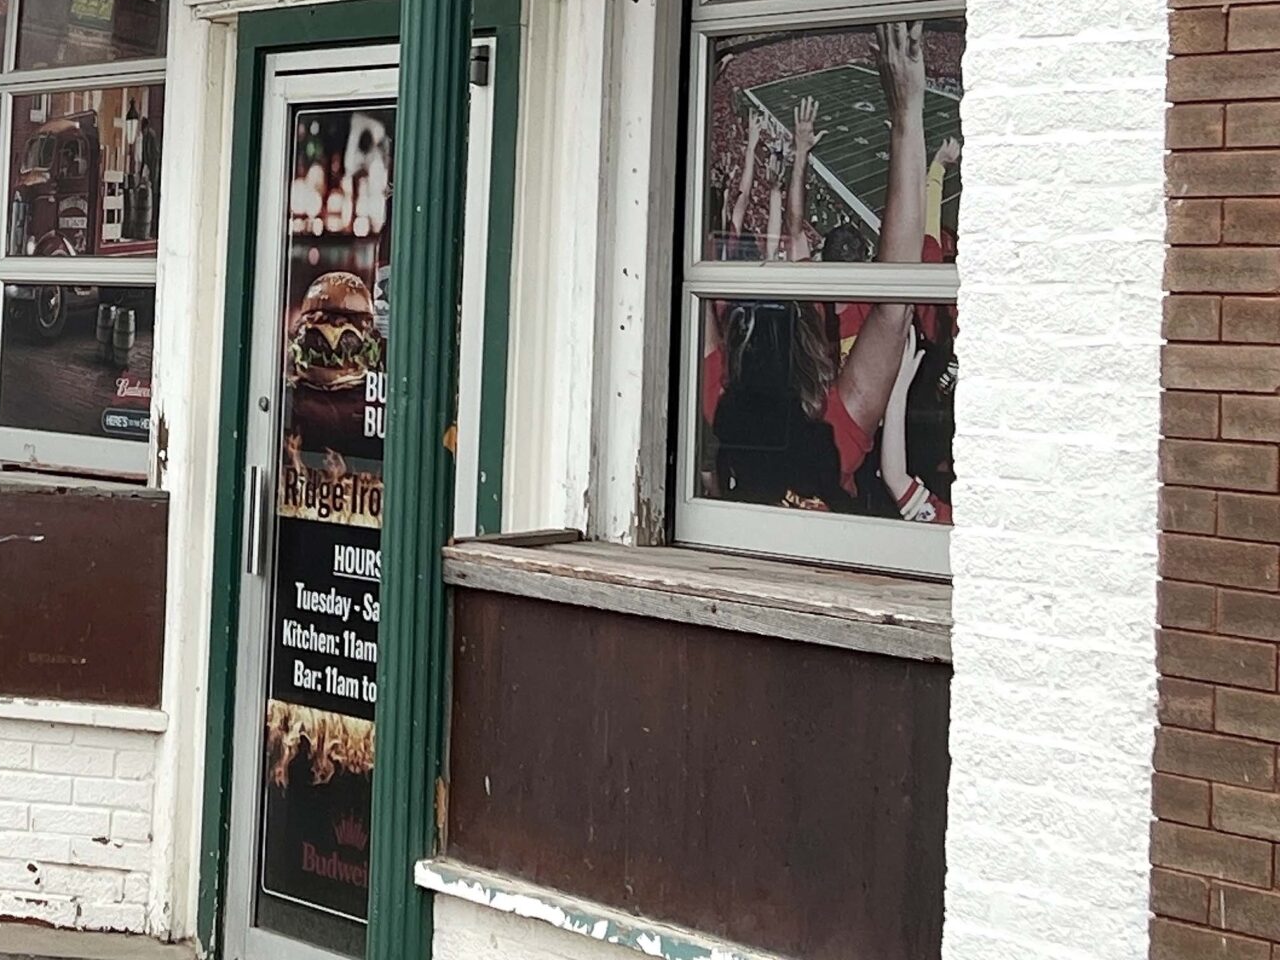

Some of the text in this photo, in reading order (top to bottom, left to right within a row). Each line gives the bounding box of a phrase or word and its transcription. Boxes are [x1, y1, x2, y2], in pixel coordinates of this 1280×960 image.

[284, 468, 344, 518] Ridge
[295, 581, 352, 622] Tuesday
[353, 604, 361, 612] -
[282, 618, 378, 664] Kitchen: 11am
[293, 659, 378, 703] Bar: 11am to
